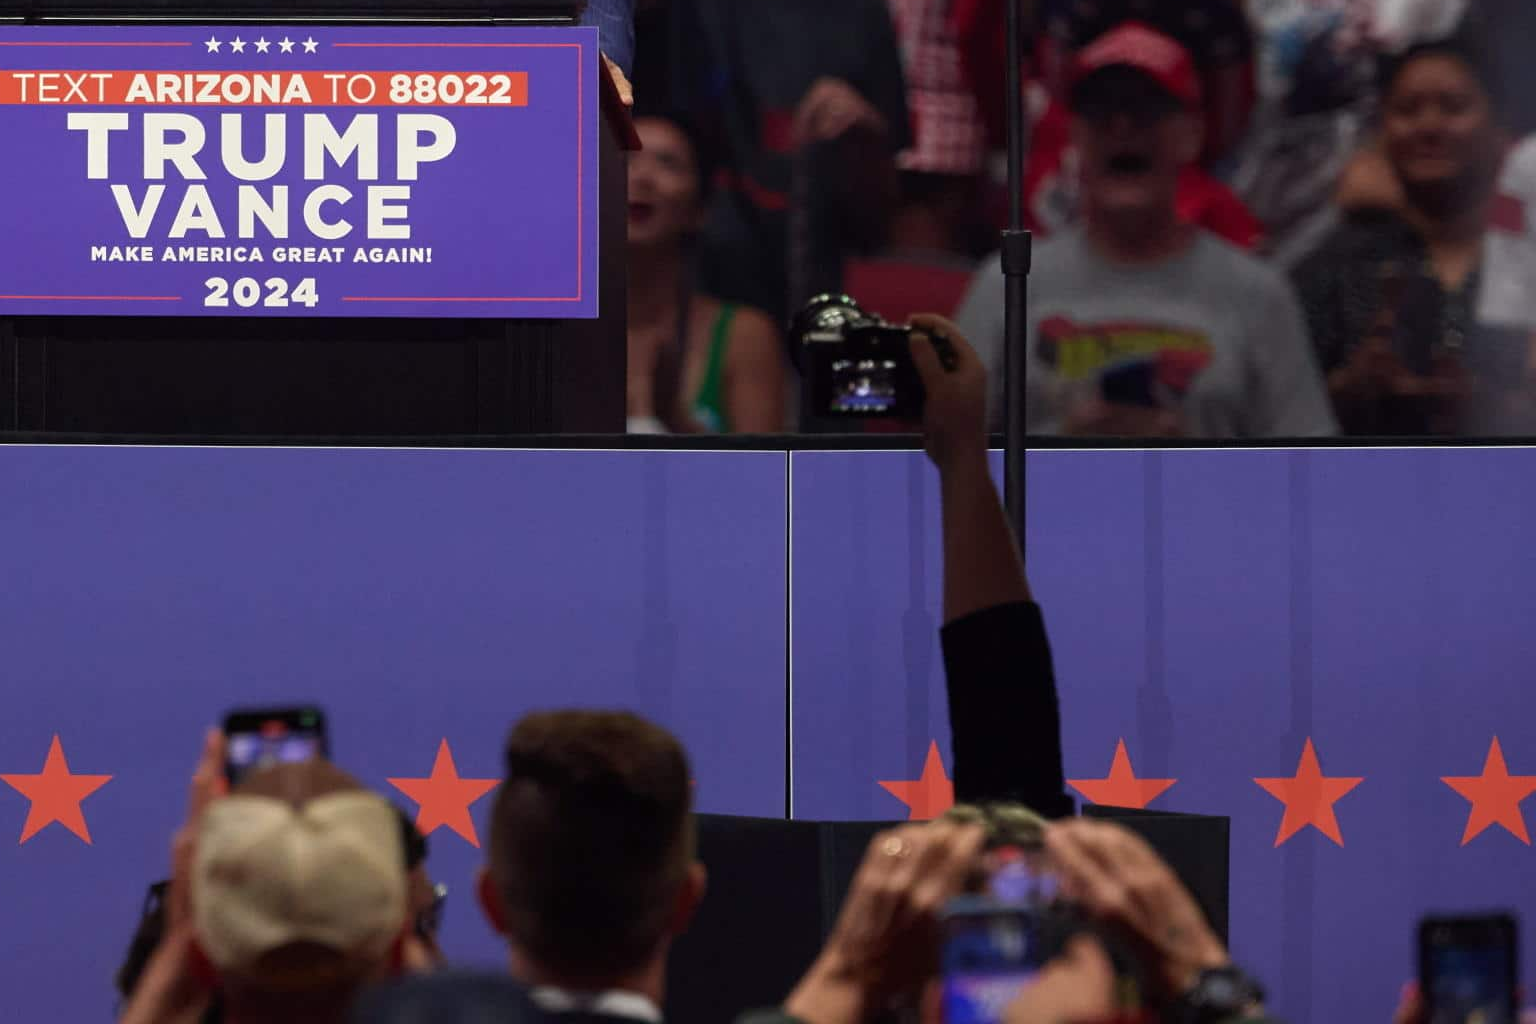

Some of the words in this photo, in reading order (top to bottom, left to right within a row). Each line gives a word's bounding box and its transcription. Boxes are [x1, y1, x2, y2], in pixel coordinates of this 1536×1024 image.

[12, 73, 113, 103] TEXT
[124, 73, 313, 104] ARIZONA
[323, 73, 376, 104] TO
[388, 73, 512, 104] 88022
[67, 112, 457, 181] TRUMP
[110, 184, 411, 240] VANCE
[91, 246, 154, 262] MAKE
[161, 246, 264, 263] AMERICA
[272, 247, 345, 263] GREAT
[352, 247, 432, 263] AGAIN!
[204, 276, 319, 308] 2024
